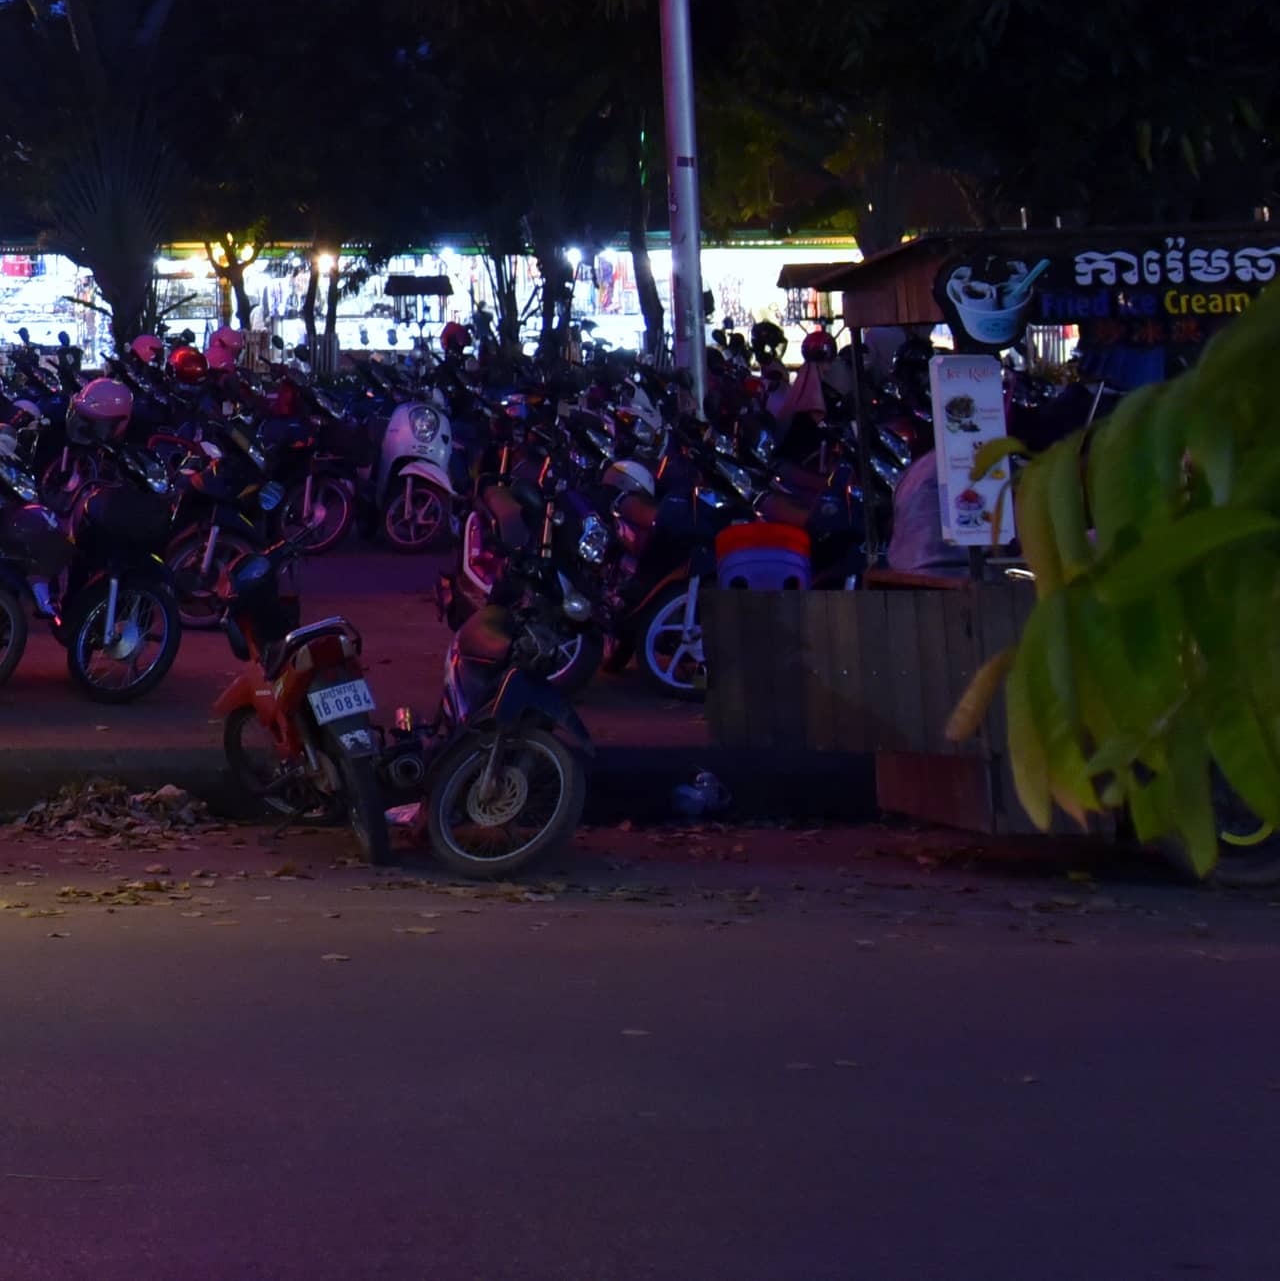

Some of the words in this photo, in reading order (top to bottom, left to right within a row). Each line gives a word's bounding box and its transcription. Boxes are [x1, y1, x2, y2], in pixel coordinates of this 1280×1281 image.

[1073, 236, 1280, 286] ការ៉េមឆ
[1041, 291, 1110, 317] Fried
[1163, 289, 1251, 316] Cream
